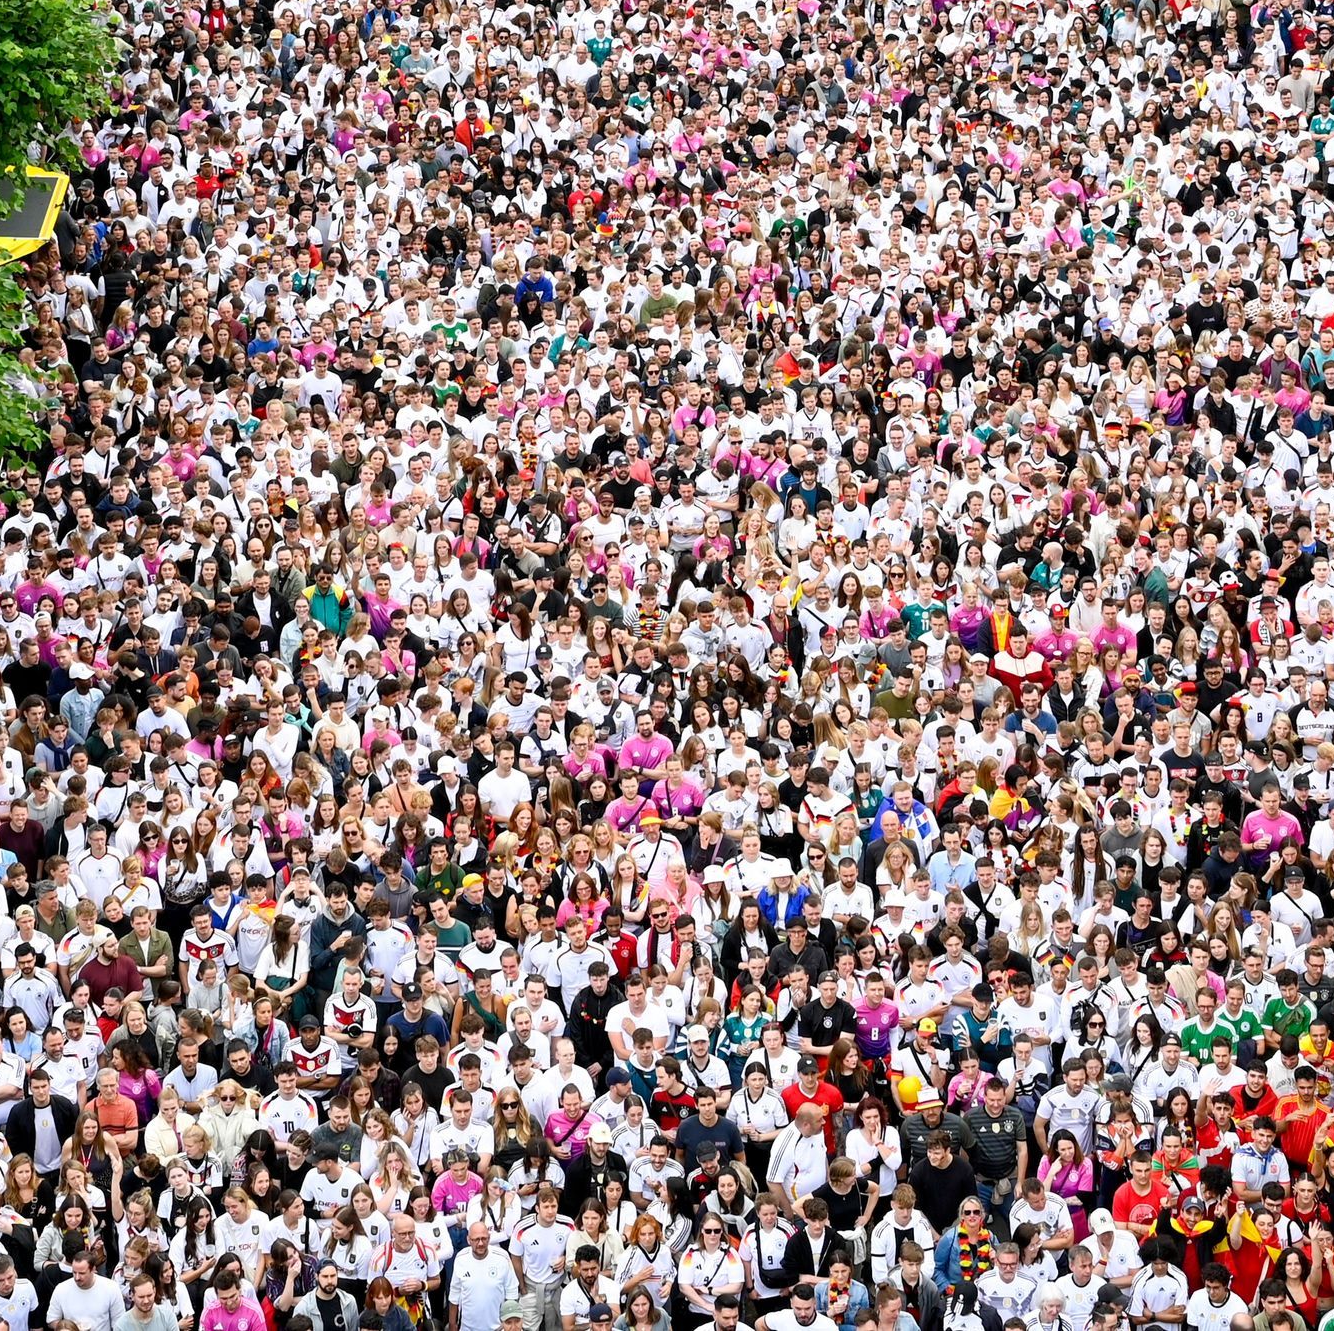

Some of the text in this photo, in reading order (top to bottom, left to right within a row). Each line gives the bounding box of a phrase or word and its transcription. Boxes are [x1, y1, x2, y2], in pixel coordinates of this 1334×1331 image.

[871, 1027, 878, 1040] 8
[1199, 1048, 1208, 1060] 10
[283, 1121, 295, 1134] 10
[394, 1199, 402, 1210] 9
[767, 1255, 773, 1265] 9
